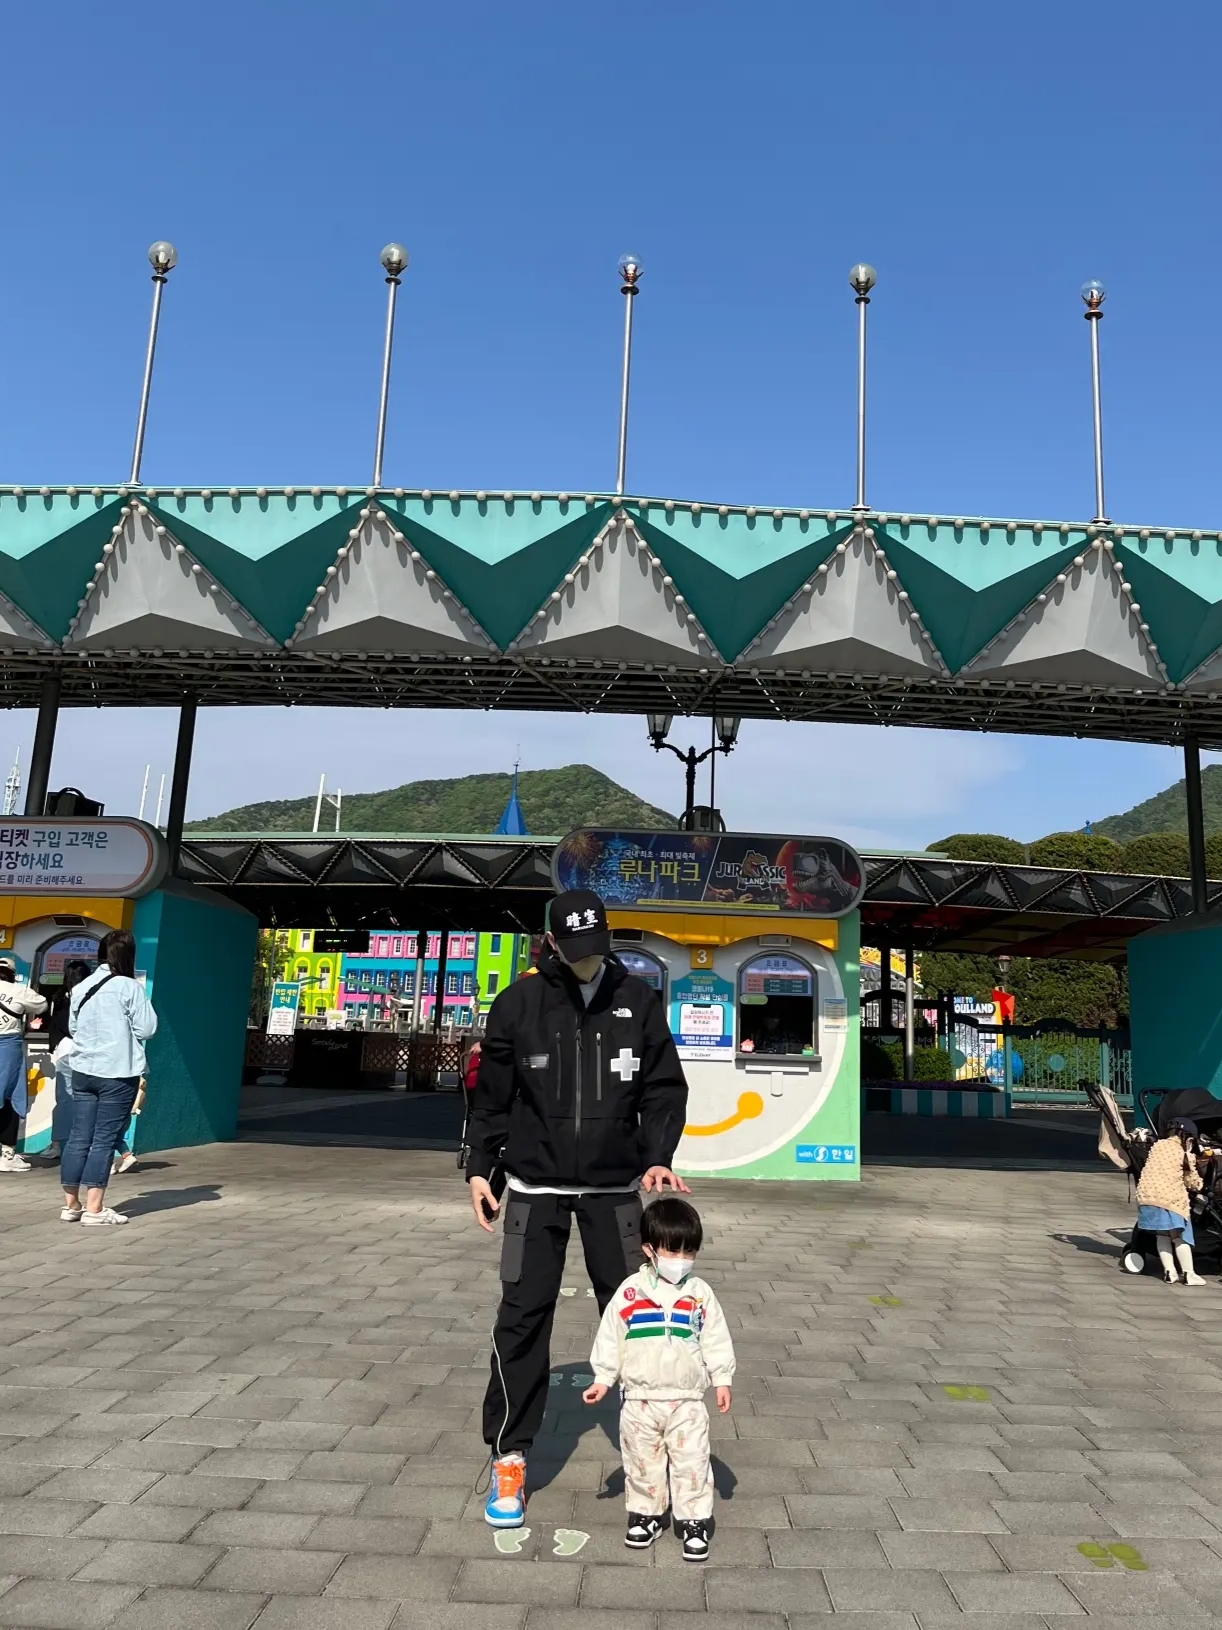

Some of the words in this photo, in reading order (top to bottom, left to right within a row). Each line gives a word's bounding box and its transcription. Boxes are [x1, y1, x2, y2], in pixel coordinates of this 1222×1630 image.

[33, 831, 61, 848] 구입
[65, 831, 109, 849] 고객은
[624, 849, 639, 859] 국내
[640, 850, 655, 859] 최초
[660, 851, 675, 860] 최대
[17, 875, 34, 885] 미리
[35, 875, 87, 886] 준비해주세요.
[696, 949, 708, 964] 3
[954, 1003, 994, 1013] OULLAND
